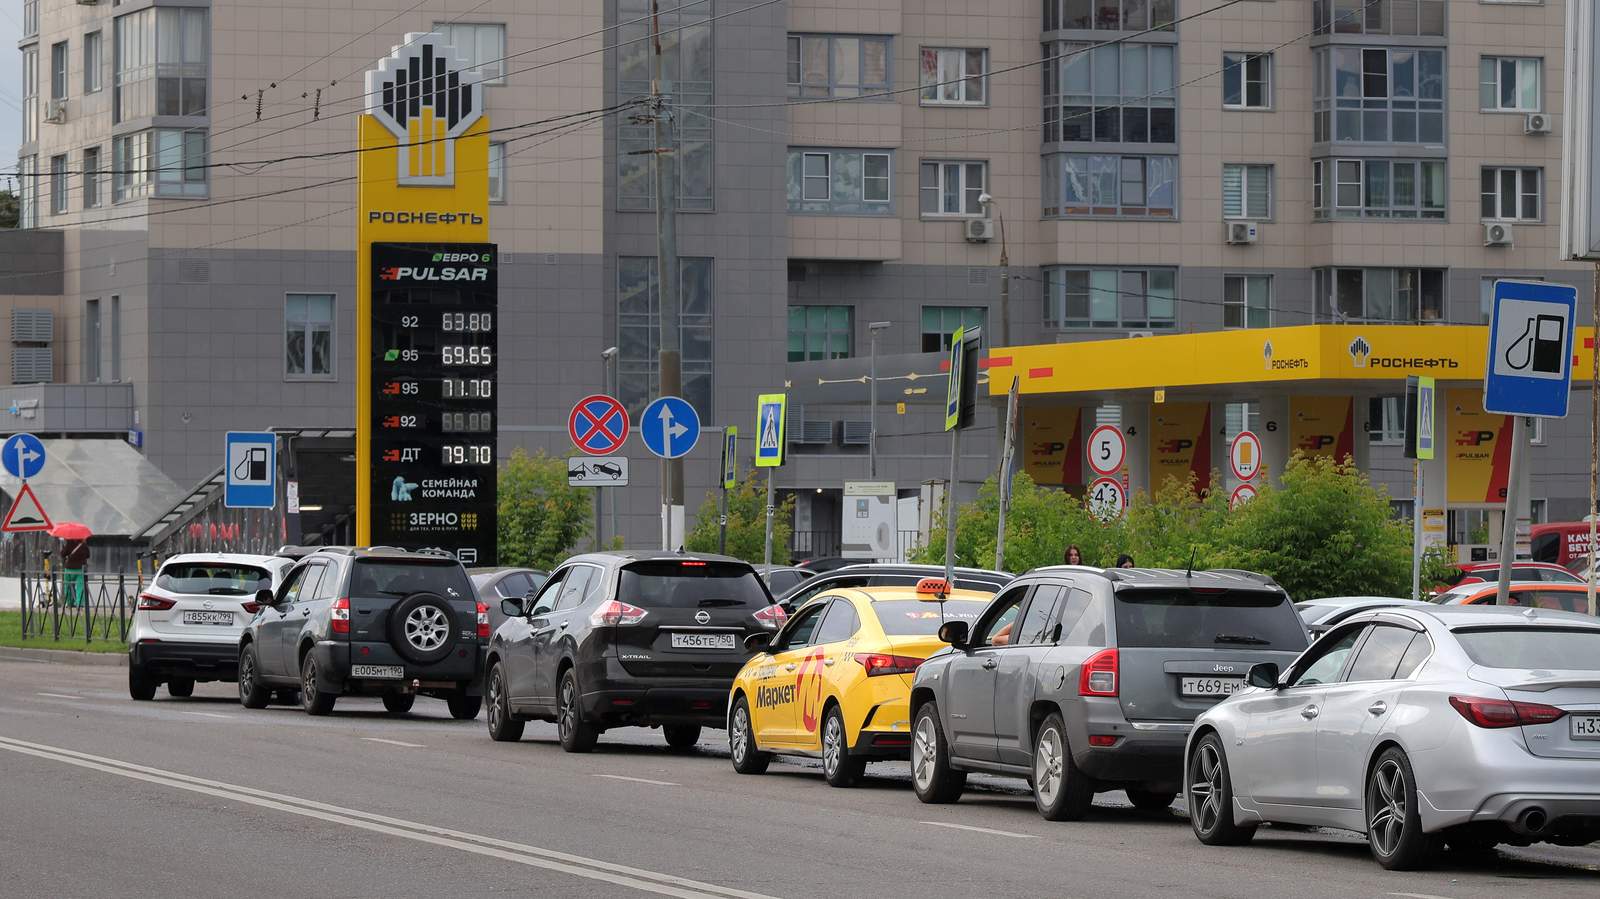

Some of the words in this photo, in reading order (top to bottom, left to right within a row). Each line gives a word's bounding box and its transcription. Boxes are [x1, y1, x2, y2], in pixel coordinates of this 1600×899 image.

[369, 211, 483, 224] РОСНЕФТЬ
[442, 253, 479, 262] ЕВРО
[481, 253, 491, 262] 6
[396, 267, 488, 281] PULSAR
[402, 316, 419, 328] 92
[442, 313, 491, 331] 63.80
[402, 350, 419, 361] 95
[442, 346, 491, 364] 69.65
[1272, 359, 1308, 369] РОСНЕФТЬ
[1370, 358, 1459, 368] РОСНЕФТЬ
[402, 382, 419, 394] 95
[442, 379, 491, 398] 71.70
[400, 415, 417, 427] 92
[1266, 421, 1277, 432] 6
[1127, 426, 1137, 436] 4
[401, 448, 421, 463] ДТ
[442, 446, 491, 464] 79.70
[1101, 441, 1111, 460] 5
[421, 478, 478, 488] СЕМЕЙНАЯ
[422, 489, 476, 499] КОМАНДА
[409, 512, 458, 525] ЗЕРНО
[1213, 664, 1234, 673] Jeep
[1188, 680, 1240, 693] Т669ЕМ
[756, 684, 796, 710] Маркет
